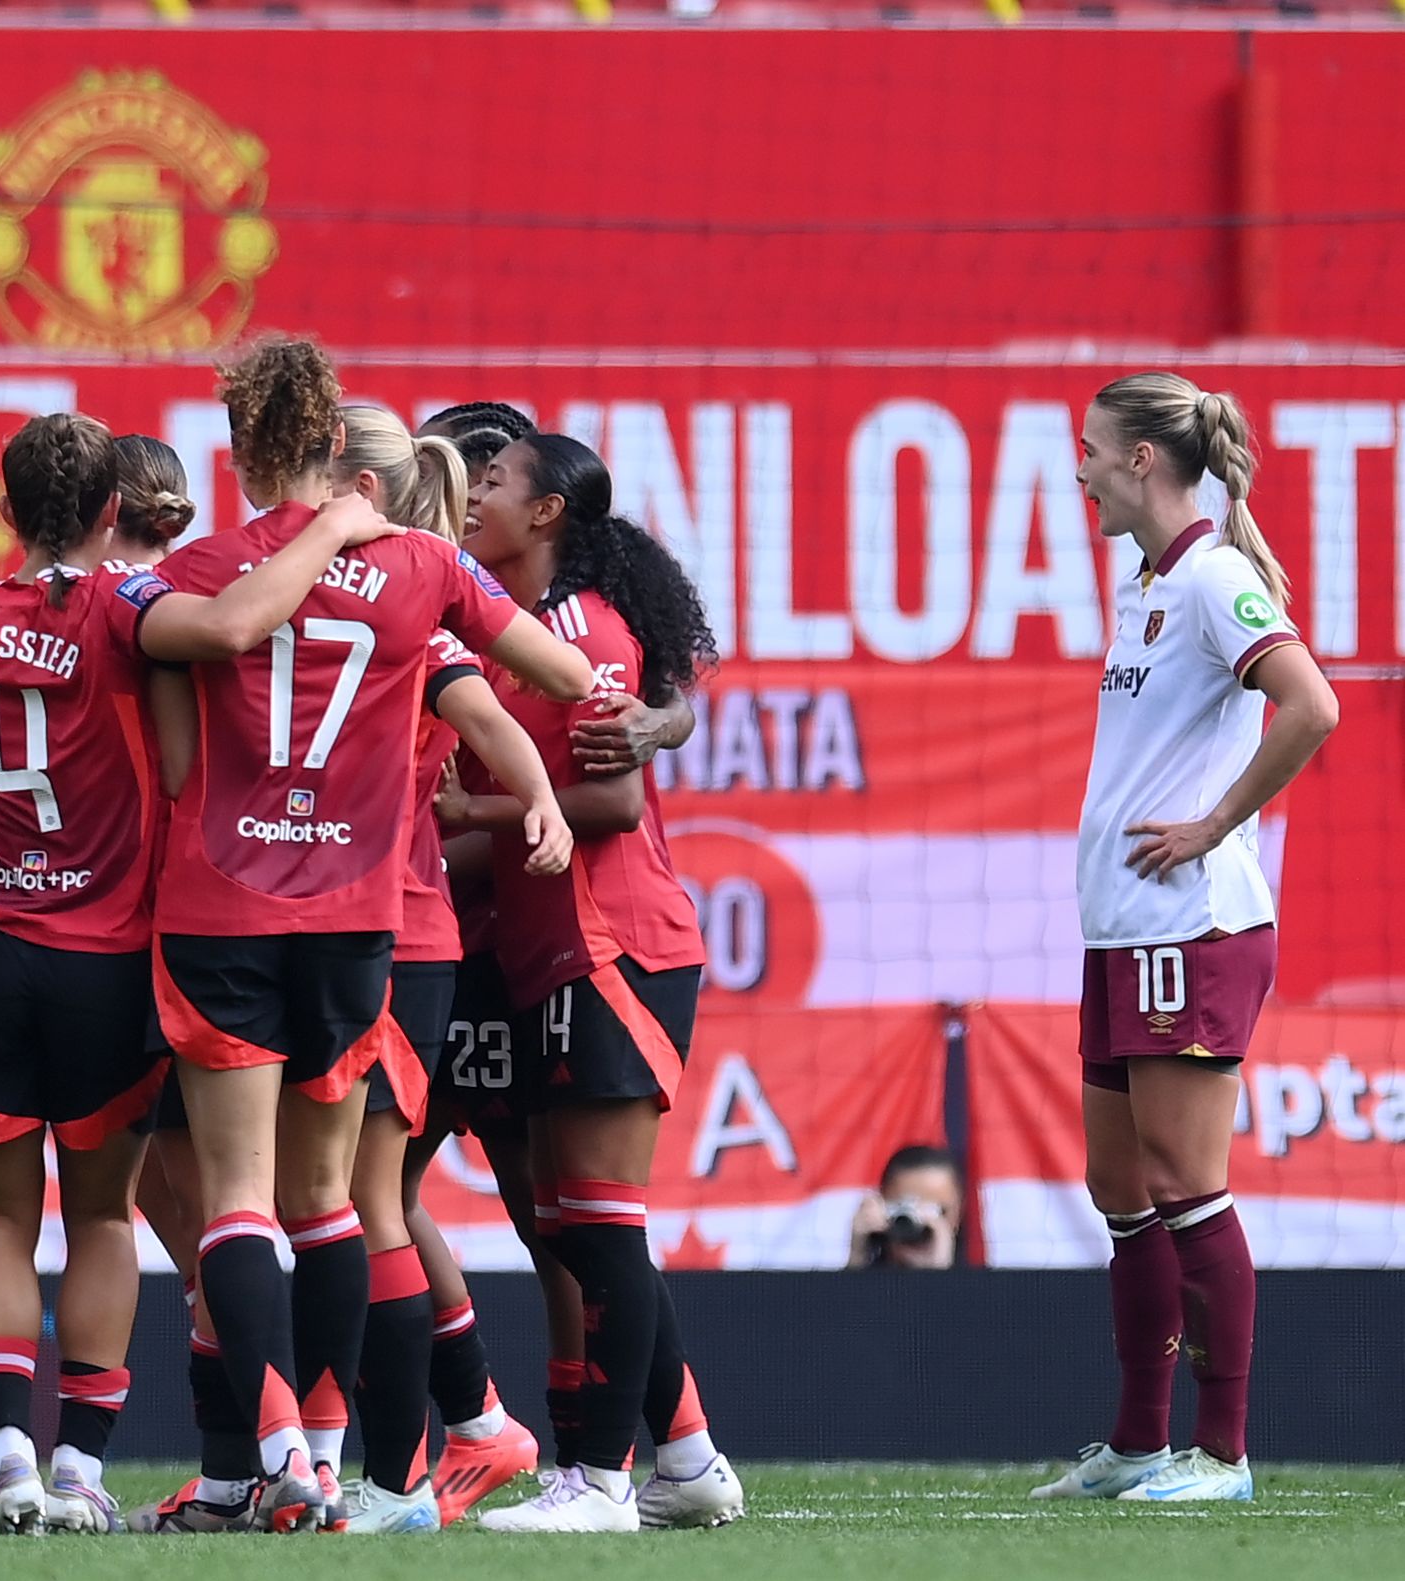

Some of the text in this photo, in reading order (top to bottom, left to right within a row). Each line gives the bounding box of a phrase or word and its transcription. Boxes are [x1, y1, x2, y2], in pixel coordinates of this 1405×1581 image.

[161, 396, 1405, 663] NLOA T
[268, 617, 376, 769] 17
[592, 663, 627, 690] XC
[1101, 664, 1151, 698] etway
[237, 815, 352, 845] Copilot+PC
[1133, 947, 1187, 1014] 10
[446, 1020, 512, 1089] 23
[1232, 1054, 1405, 1158] pta
